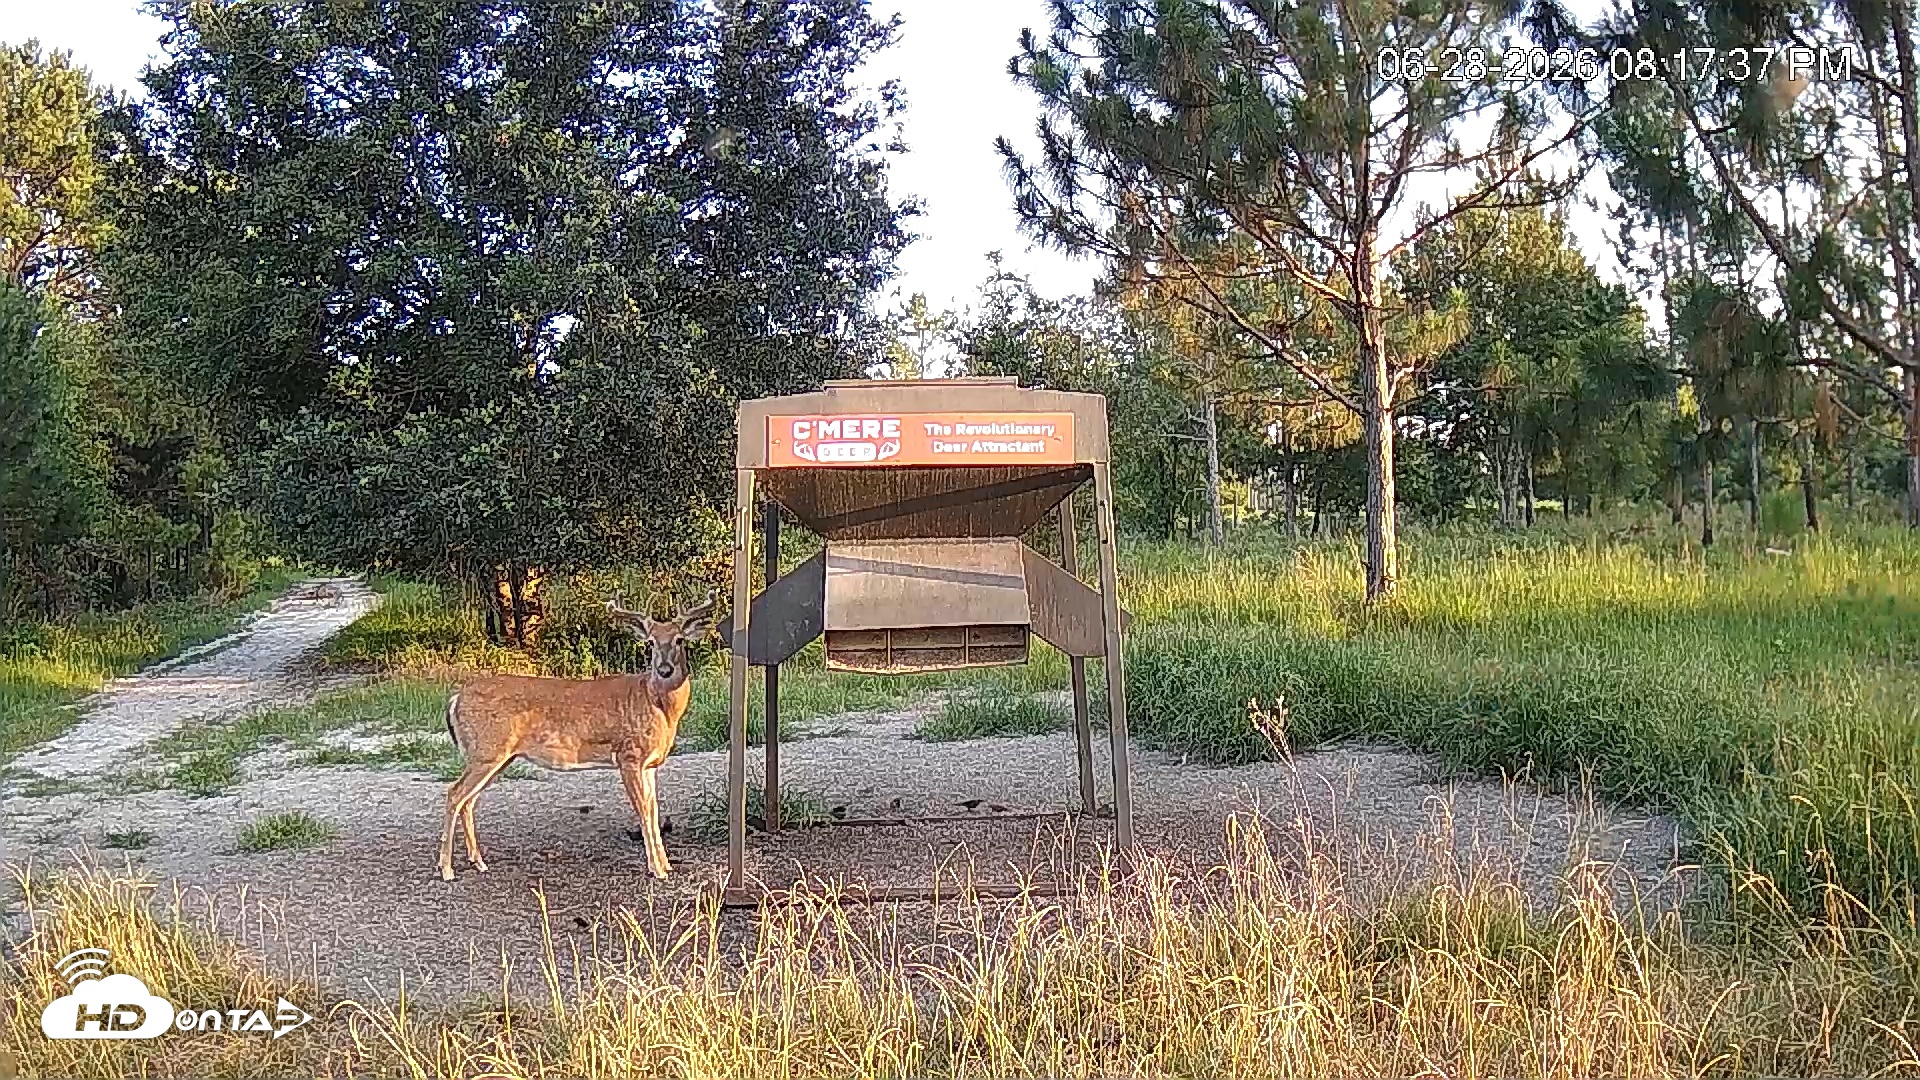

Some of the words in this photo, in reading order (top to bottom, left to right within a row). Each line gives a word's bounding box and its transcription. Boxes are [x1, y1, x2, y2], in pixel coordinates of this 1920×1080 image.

[793, 419, 901, 439] C'MERE
[924, 423, 950, 436] The
[956, 422, 1055, 438] Revolutionary
[933, 441, 967, 453] Deer
[971, 439, 1045, 453] Attractant
